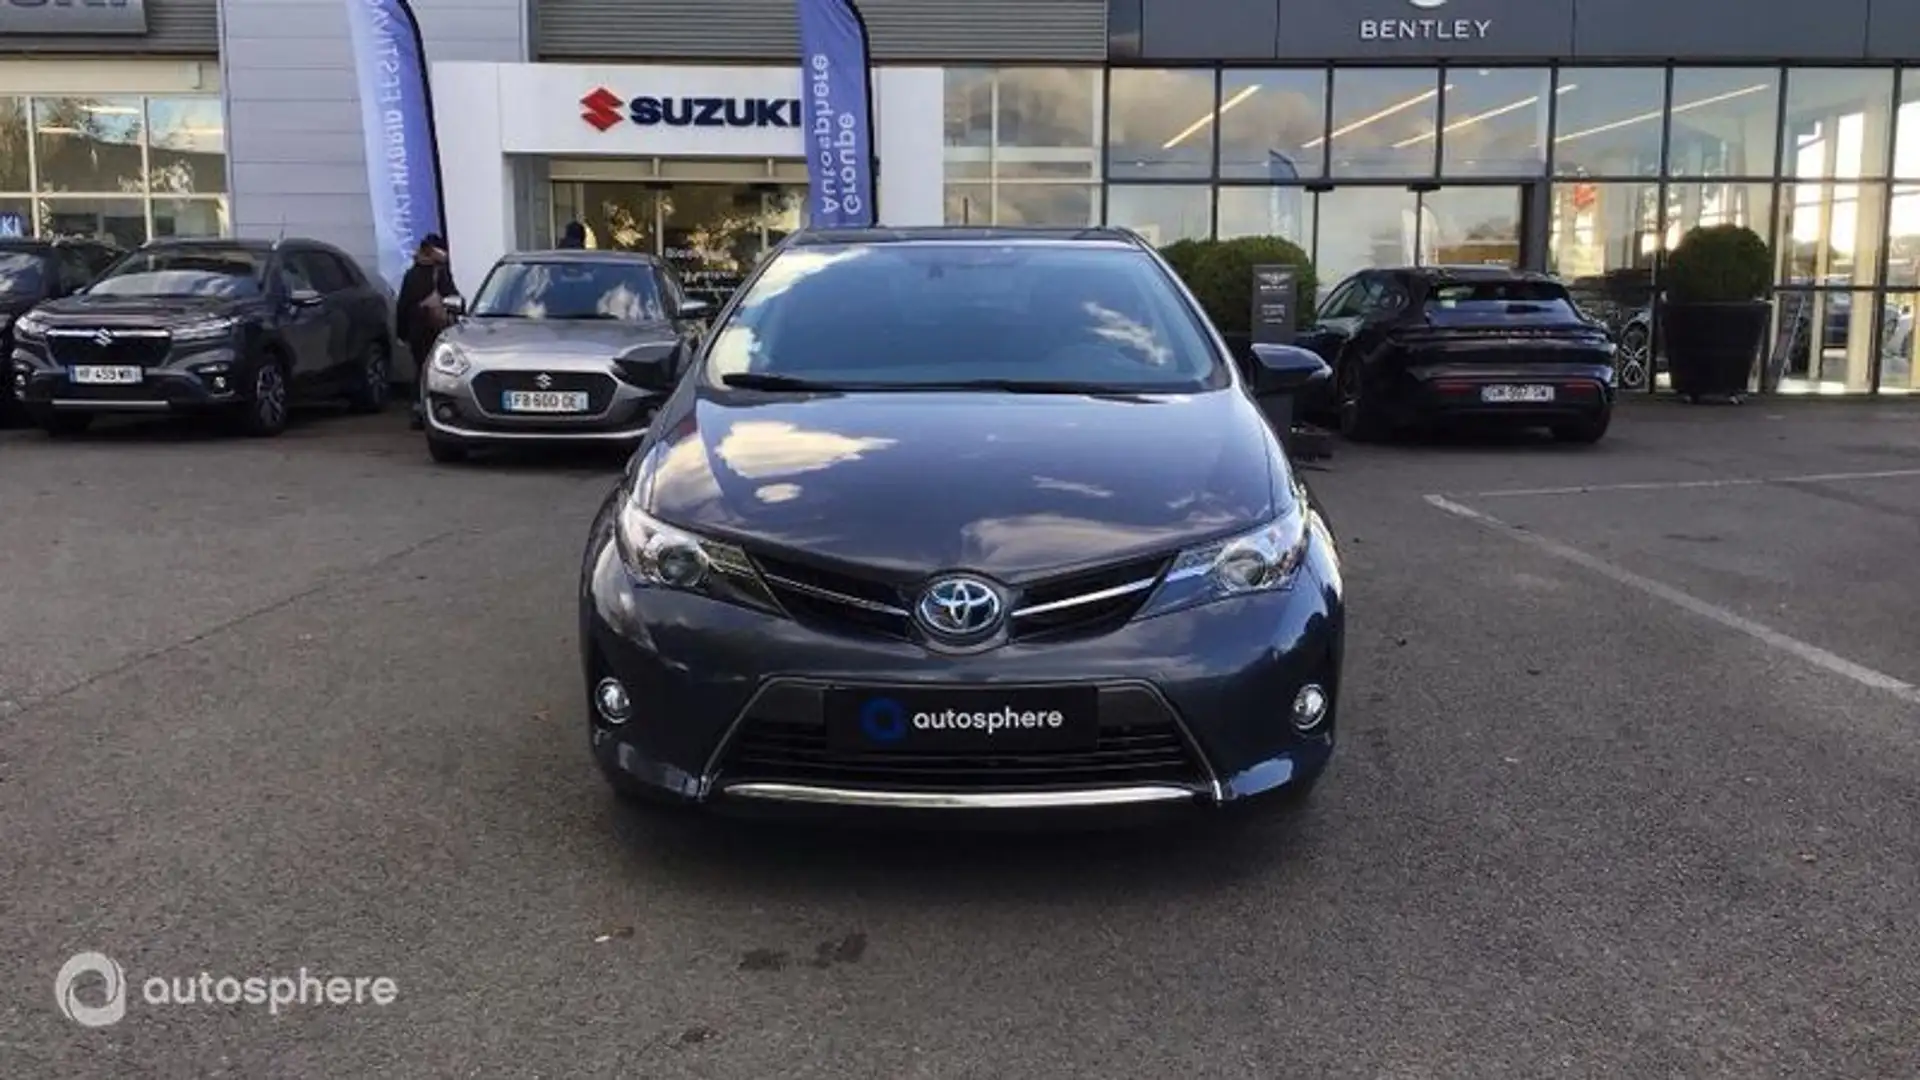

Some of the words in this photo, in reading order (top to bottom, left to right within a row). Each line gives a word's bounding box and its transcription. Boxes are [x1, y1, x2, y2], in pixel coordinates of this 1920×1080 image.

[1361, 19, 1492, 39] BENTLEY
[630, 96, 802, 127] SUZUKI
[913, 705, 1064, 735] autosphere
